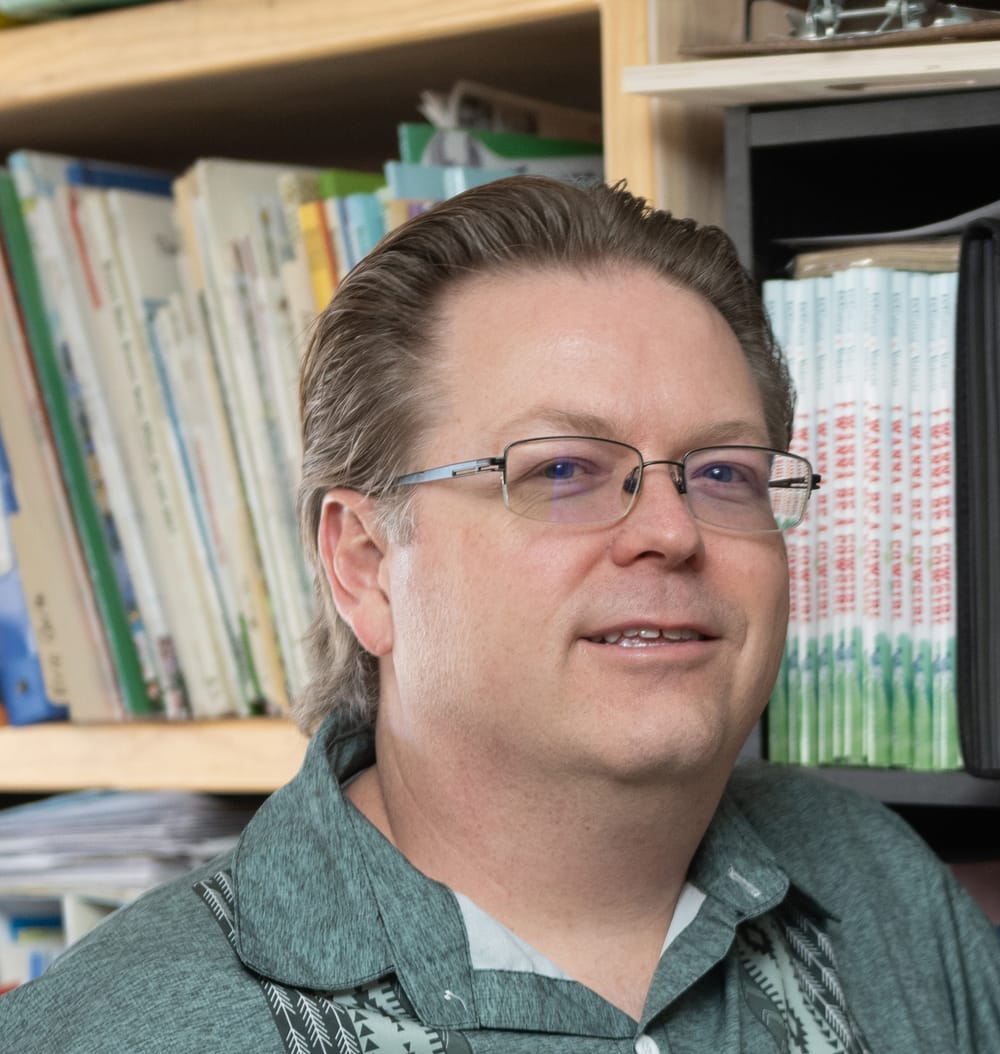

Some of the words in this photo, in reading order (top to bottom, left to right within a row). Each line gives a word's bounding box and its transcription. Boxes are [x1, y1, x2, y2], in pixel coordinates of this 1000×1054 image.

[892, 420, 903, 483] WANNA
[912, 425, 922, 489] WANNA
[892, 493, 903, 514] BE
[912, 499, 922, 520] BE
[892, 523, 902, 531] A
[912, 528, 922, 536] A
[892, 540, 902, 620] COWGIRL
[912, 546, 922, 626] COWGIRL
